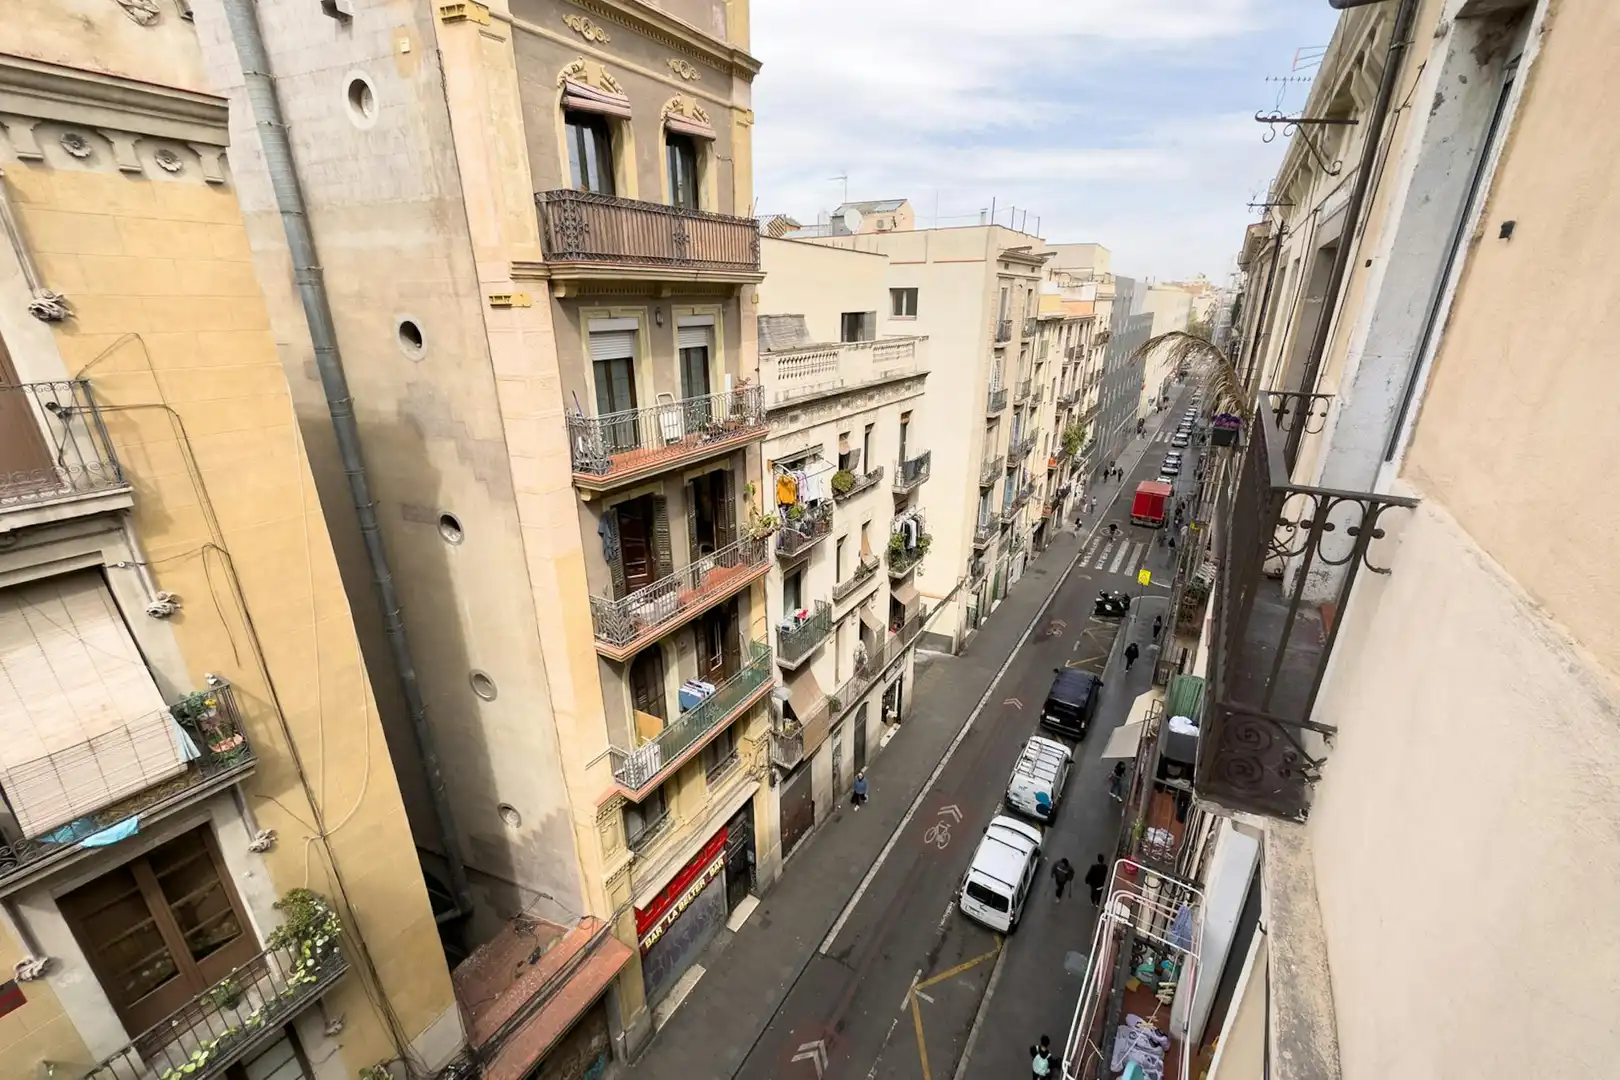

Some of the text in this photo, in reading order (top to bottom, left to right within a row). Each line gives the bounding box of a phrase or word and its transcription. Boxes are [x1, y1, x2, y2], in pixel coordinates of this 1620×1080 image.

[644, 927, 663, 949] BAR
[667, 909, 679, 923] LA
[709, 858, 724, 877] BAR
